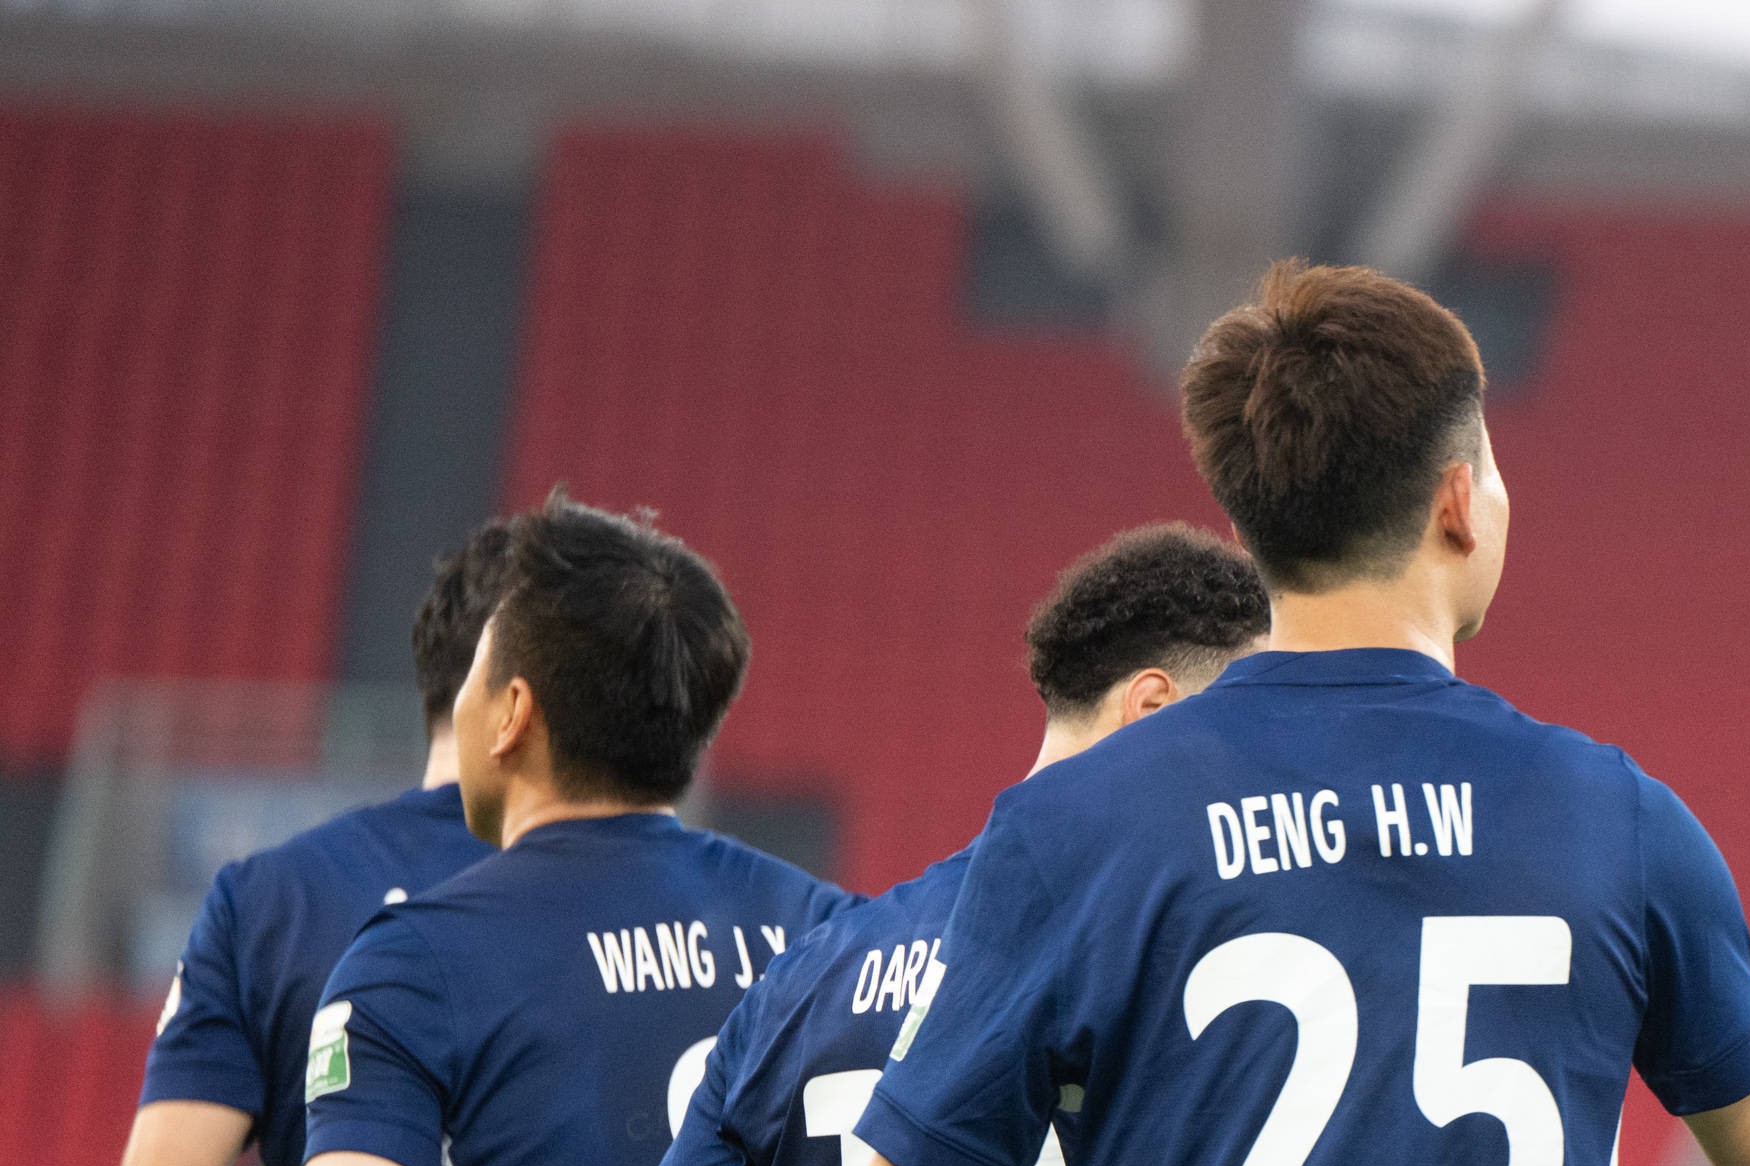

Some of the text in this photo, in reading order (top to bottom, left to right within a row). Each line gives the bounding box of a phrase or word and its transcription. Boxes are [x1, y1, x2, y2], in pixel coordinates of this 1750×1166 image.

[1206, 782, 1472, 880] DENG H.W
[587, 920, 716, 993] WANG
